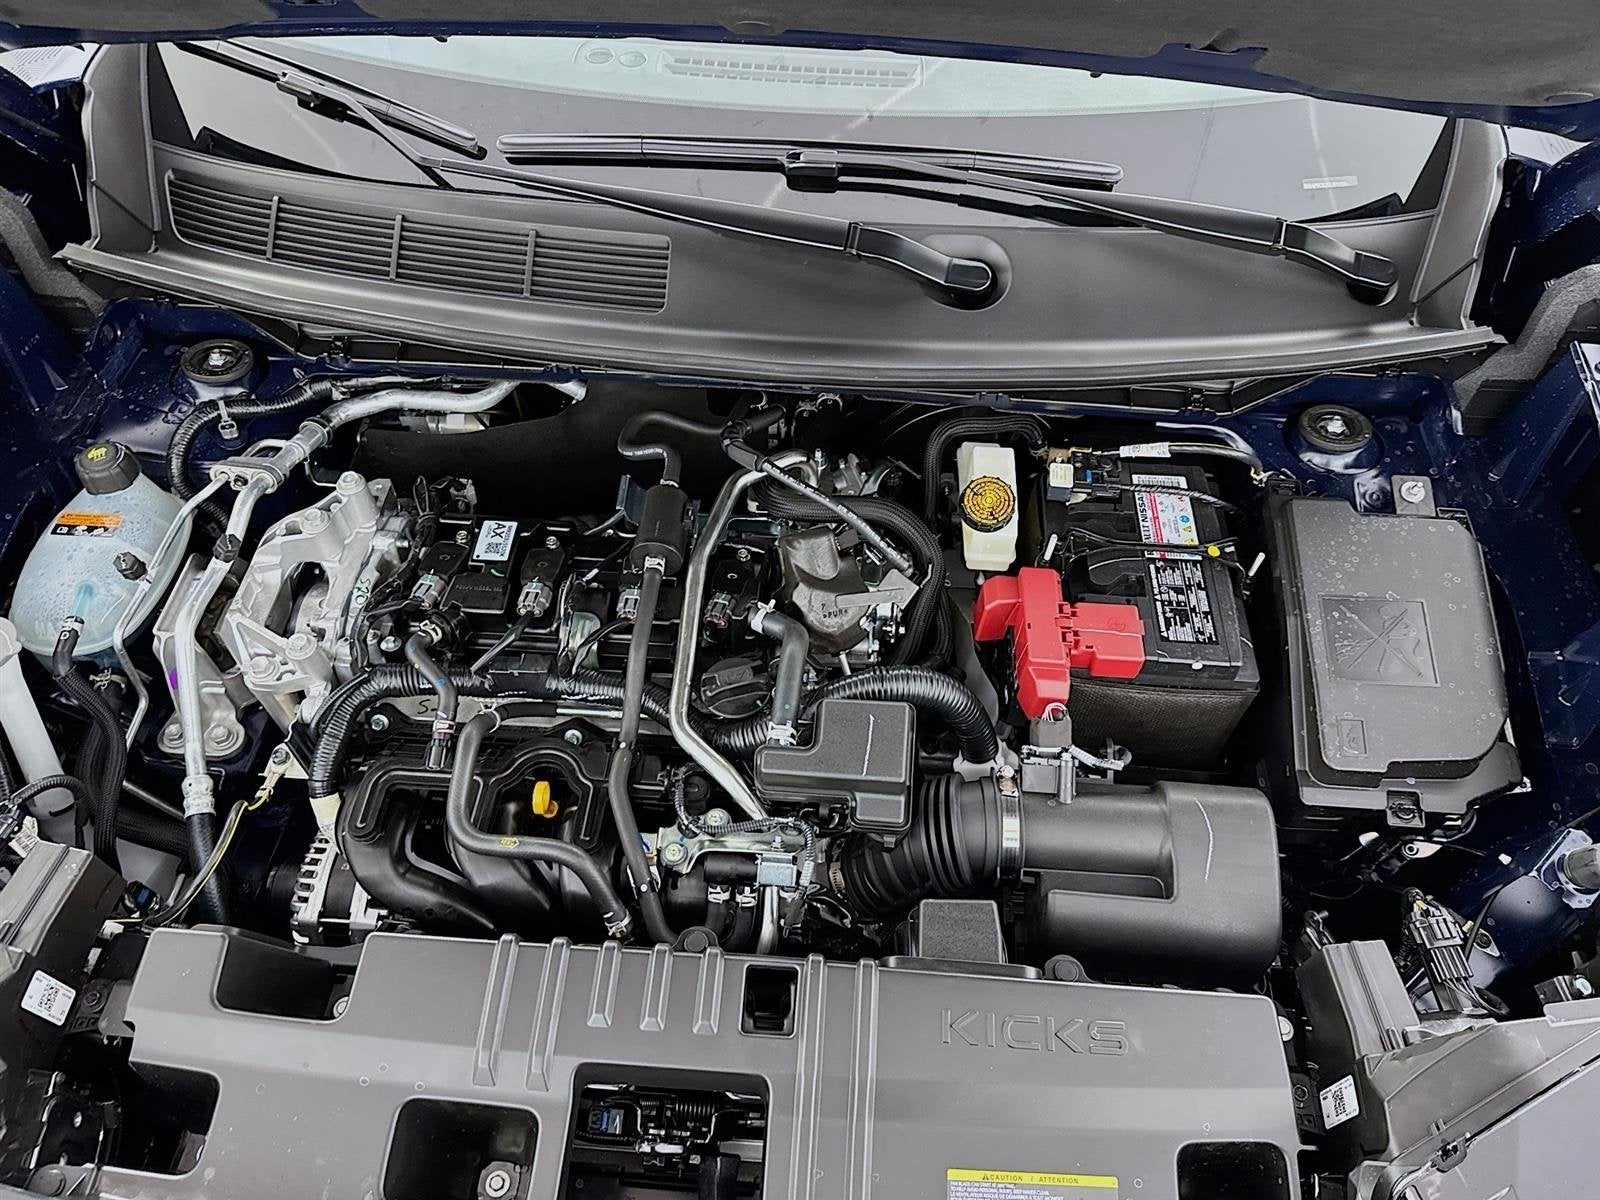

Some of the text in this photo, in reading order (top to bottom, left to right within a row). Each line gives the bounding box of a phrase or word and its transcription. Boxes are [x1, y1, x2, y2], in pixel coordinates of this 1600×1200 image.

[490, 522, 506, 539] AX
[941, 1008, 1129, 1056] KICKS
[990, 1174, 1023, 1182] CAUTION
[1039, 1176, 1079, 1184] ATTENTION
